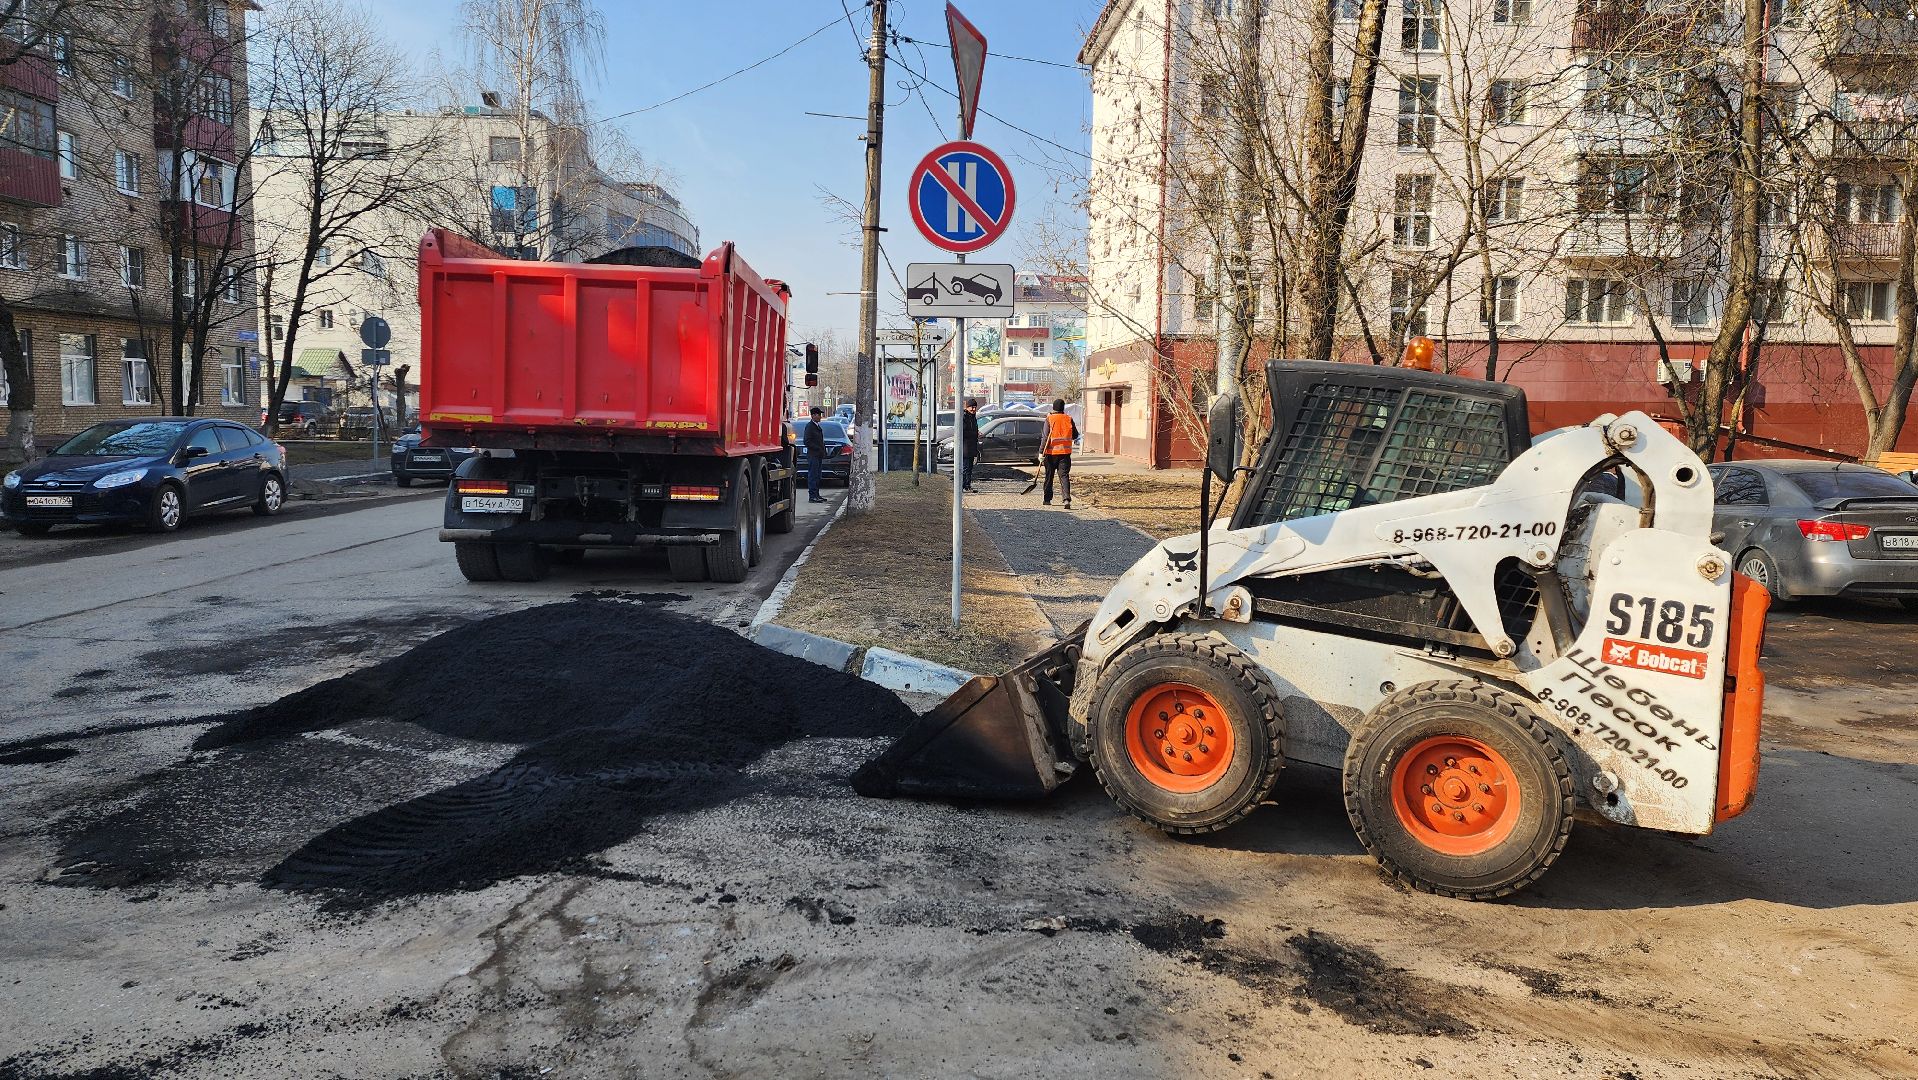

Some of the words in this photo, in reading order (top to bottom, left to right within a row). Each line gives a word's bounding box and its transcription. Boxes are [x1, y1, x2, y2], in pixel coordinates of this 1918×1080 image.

[1393, 521, 1557, 544] 8-968-720-21-00
[1885, 537, 1918, 547] В818У
[1606, 592, 1716, 649] S185
[1636, 649, 1699, 675] Bobcat
[1560, 671, 1682, 752] Песок
[1565, 648, 1718, 751] Щебень
[1537, 687, 1689, 789] 8-968-720-21-00
